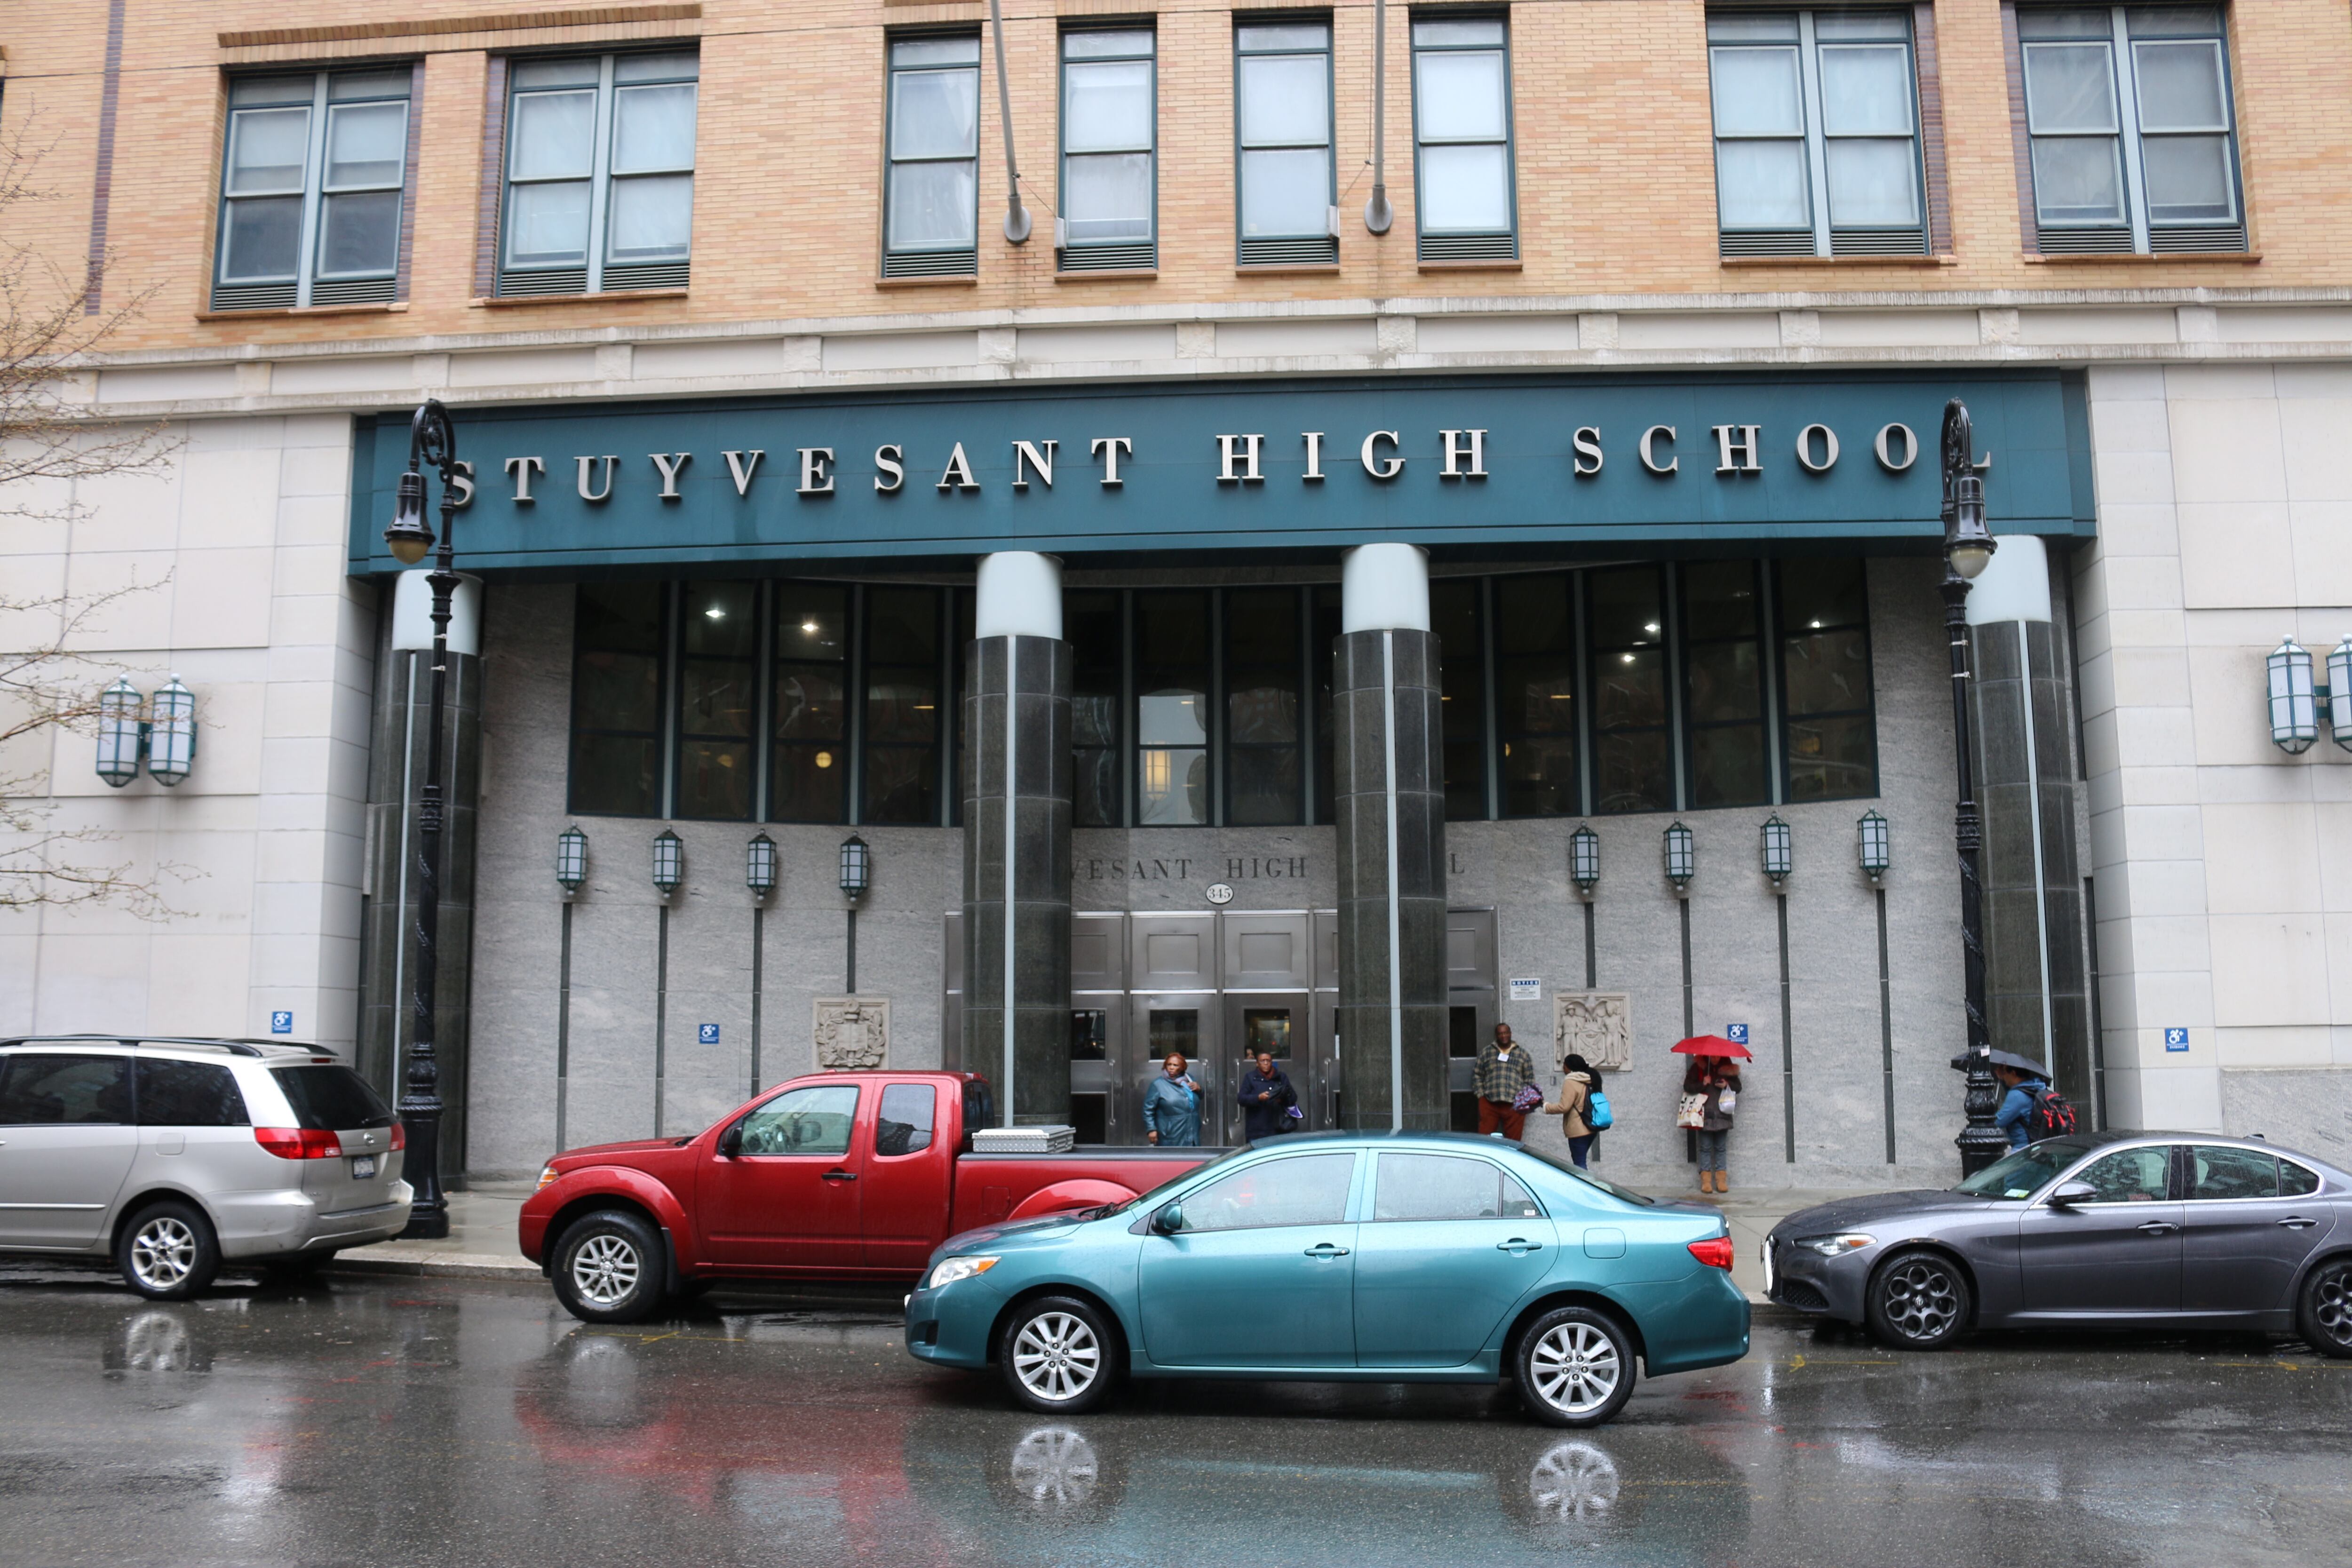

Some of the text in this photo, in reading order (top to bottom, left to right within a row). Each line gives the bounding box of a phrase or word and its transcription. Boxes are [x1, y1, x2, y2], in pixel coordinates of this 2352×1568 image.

[452, 437, 1132, 506] STUYVESANT
[1216, 429, 1489, 480] HIGH
[1226, 858, 1306, 878] HIGH
[1208, 888, 1231, 899] 345
